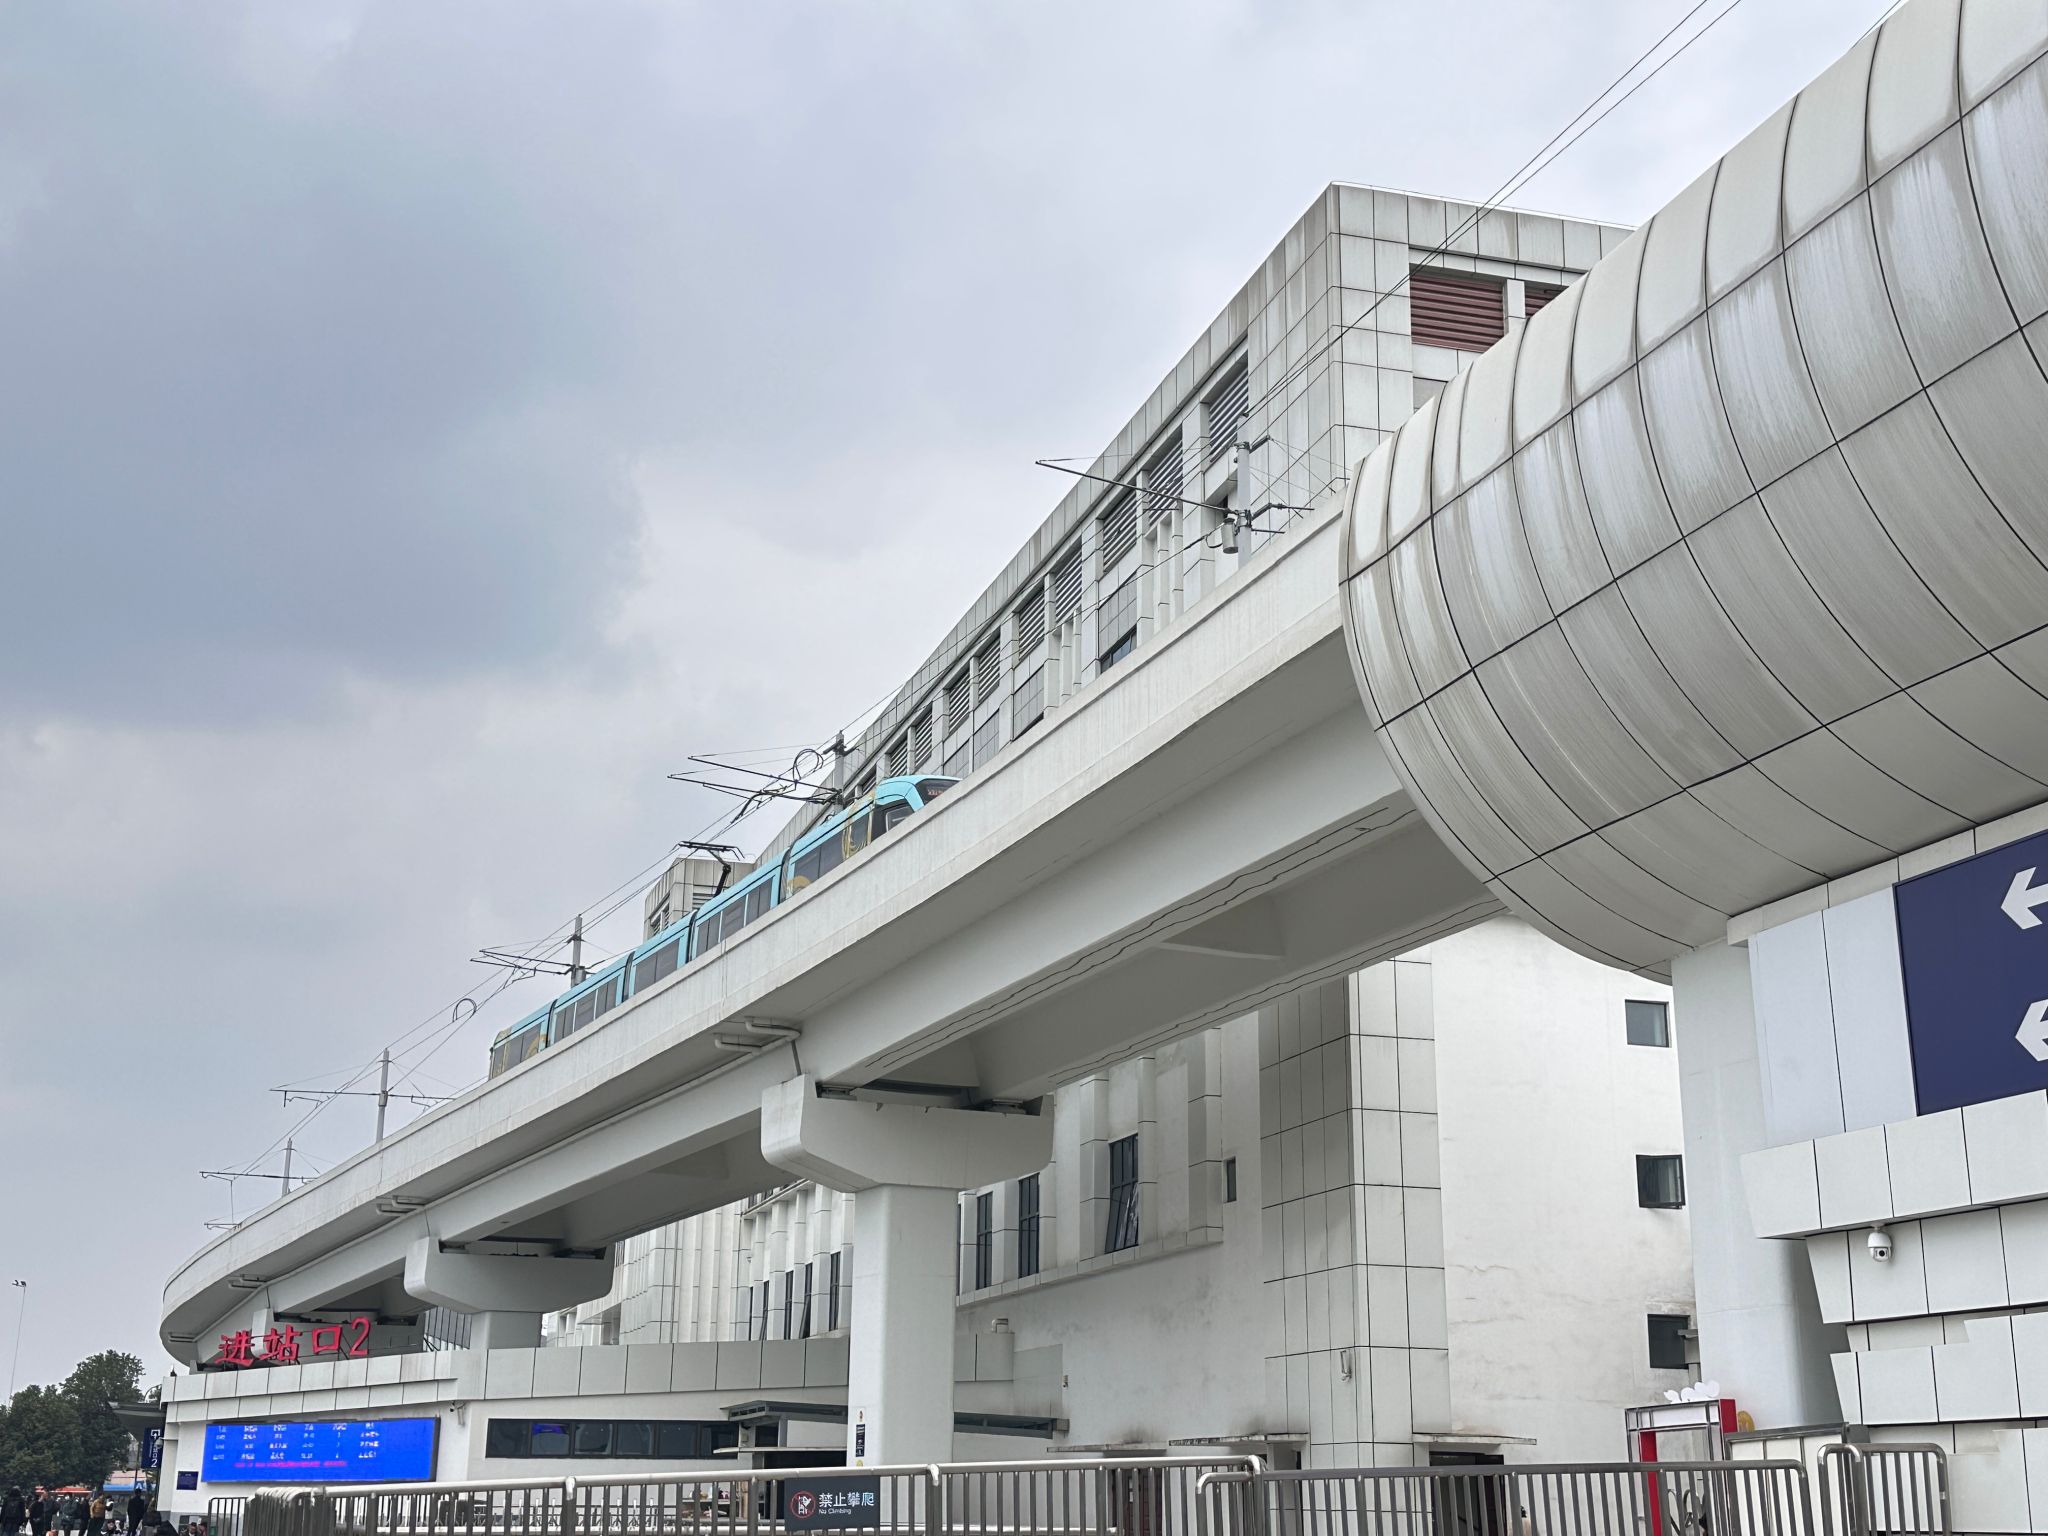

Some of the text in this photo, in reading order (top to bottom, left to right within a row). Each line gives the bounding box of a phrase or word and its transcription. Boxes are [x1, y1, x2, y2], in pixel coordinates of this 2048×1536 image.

[214, 1316, 371, 1366] 进站口2
[818, 1491, 875, 1508] 禁止攀爬
